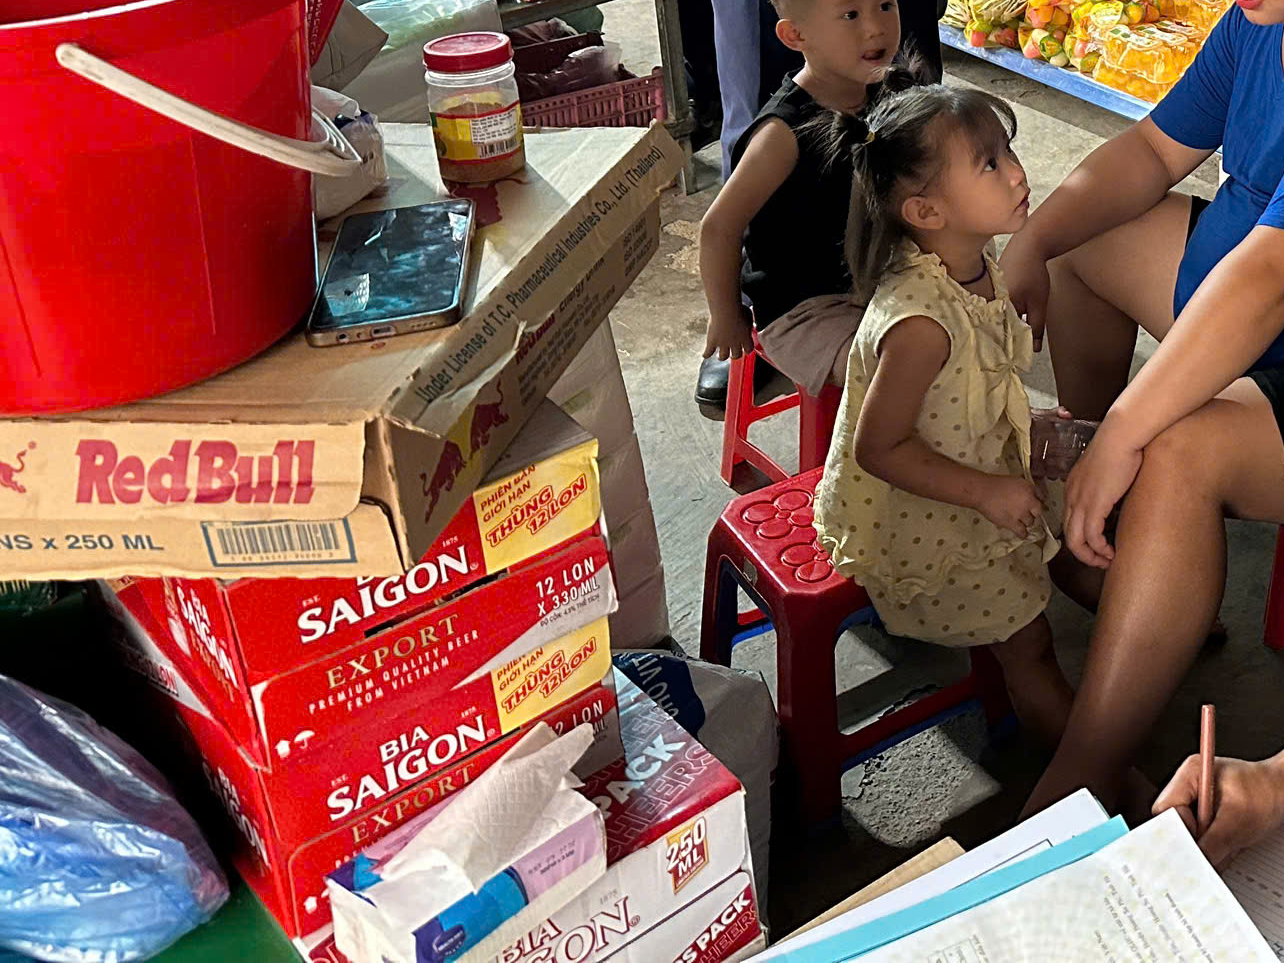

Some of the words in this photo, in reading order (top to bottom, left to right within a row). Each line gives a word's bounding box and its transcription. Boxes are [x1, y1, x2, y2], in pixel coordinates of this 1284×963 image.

[414, 365, 453, 404] Under
[444, 328, 487, 373] License
[478, 318, 497, 337] of
[488, 300, 514, 327] T.C.
[505, 244, 568, 309] Pharmaceutical
[559, 208, 601, 251] Industries
[608, 177, 631, 200] Ltd.
[625, 145, 666, 185] (Thailand)
[485, 484, 553, 548] THÙNG
[507, 480, 531, 504] HẠN
[65, 534, 114, 550] 250
[122, 535, 164, 551] ML
[298, 545, 470, 644] SAIGON
[535, 578, 555, 598] 12
[562, 556, 596, 587] LON
[308, 678, 375, 714] PREMIUM
[383, 647, 440, 682] QUALITY
[447, 629, 480, 652] BEER
[326, 613, 459, 689] EXPORT
[501, 648, 565, 714] THÙNG
[347, 686, 384, 712] FROM
[391, 655, 450, 689] VIETNAM
[327, 714, 487, 821] SAIGON
[379, 725, 431, 763] BIA
[352, 763, 475, 844] EXPORT
[665, 817, 707, 871] 250
[677, 847, 702, 877] ML
[697, 892, 751, 950] PACK
